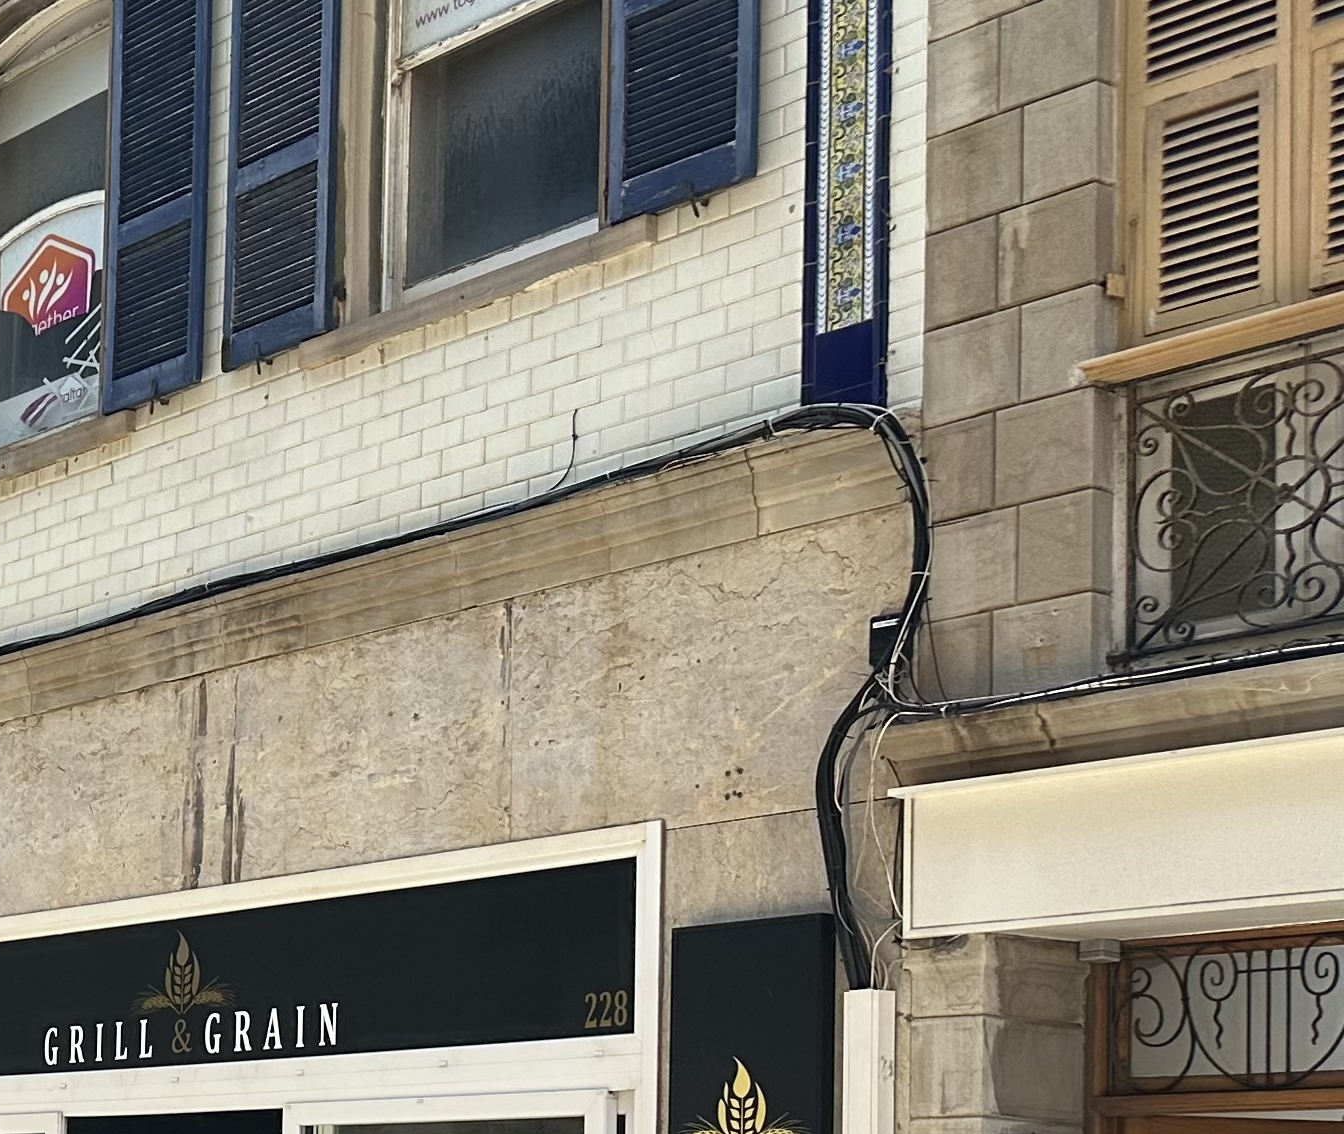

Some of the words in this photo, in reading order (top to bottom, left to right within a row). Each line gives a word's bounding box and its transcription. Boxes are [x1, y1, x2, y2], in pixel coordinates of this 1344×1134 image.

[44, 1019, 153, 1066] GRILL
[171, 1019, 192, 1053] &
[205, 1003, 338, 1054] GRAIN
[584, 990, 628, 1030] 228
